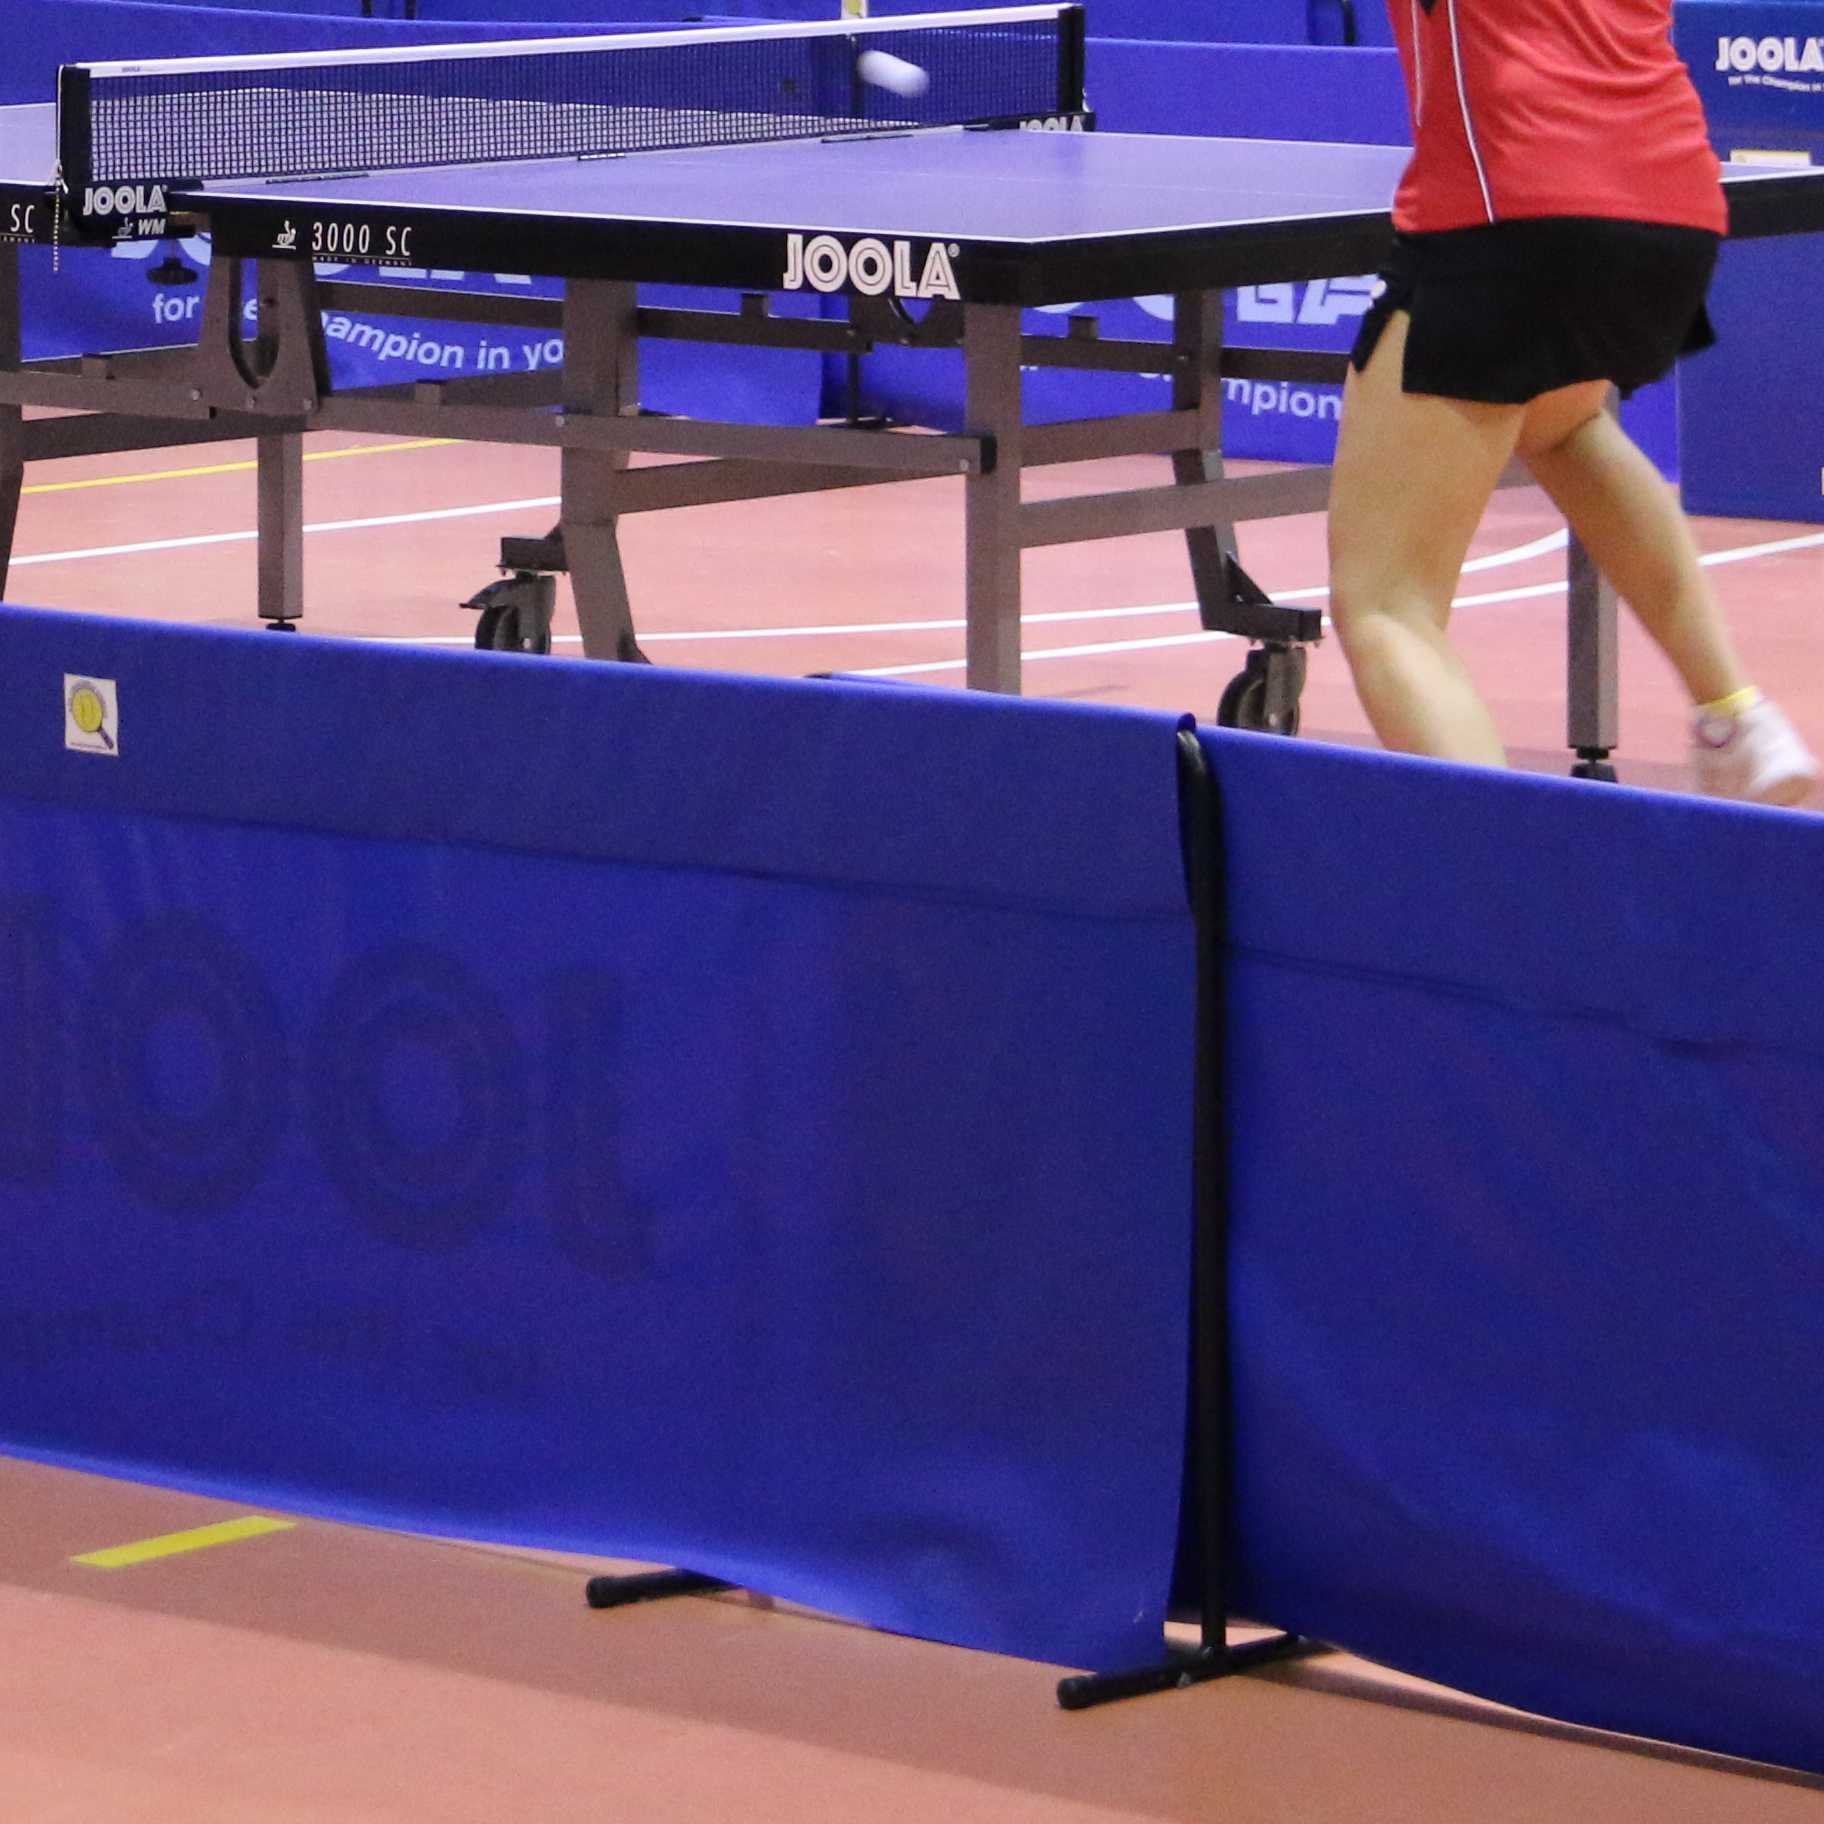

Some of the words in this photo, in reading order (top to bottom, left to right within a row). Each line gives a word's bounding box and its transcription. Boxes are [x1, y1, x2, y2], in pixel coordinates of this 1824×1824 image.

[10, 203, 36, 234] SC
[311, 220, 371, 254] 3000
[385, 224, 413, 257] SC
[477, 339, 512, 369] in
